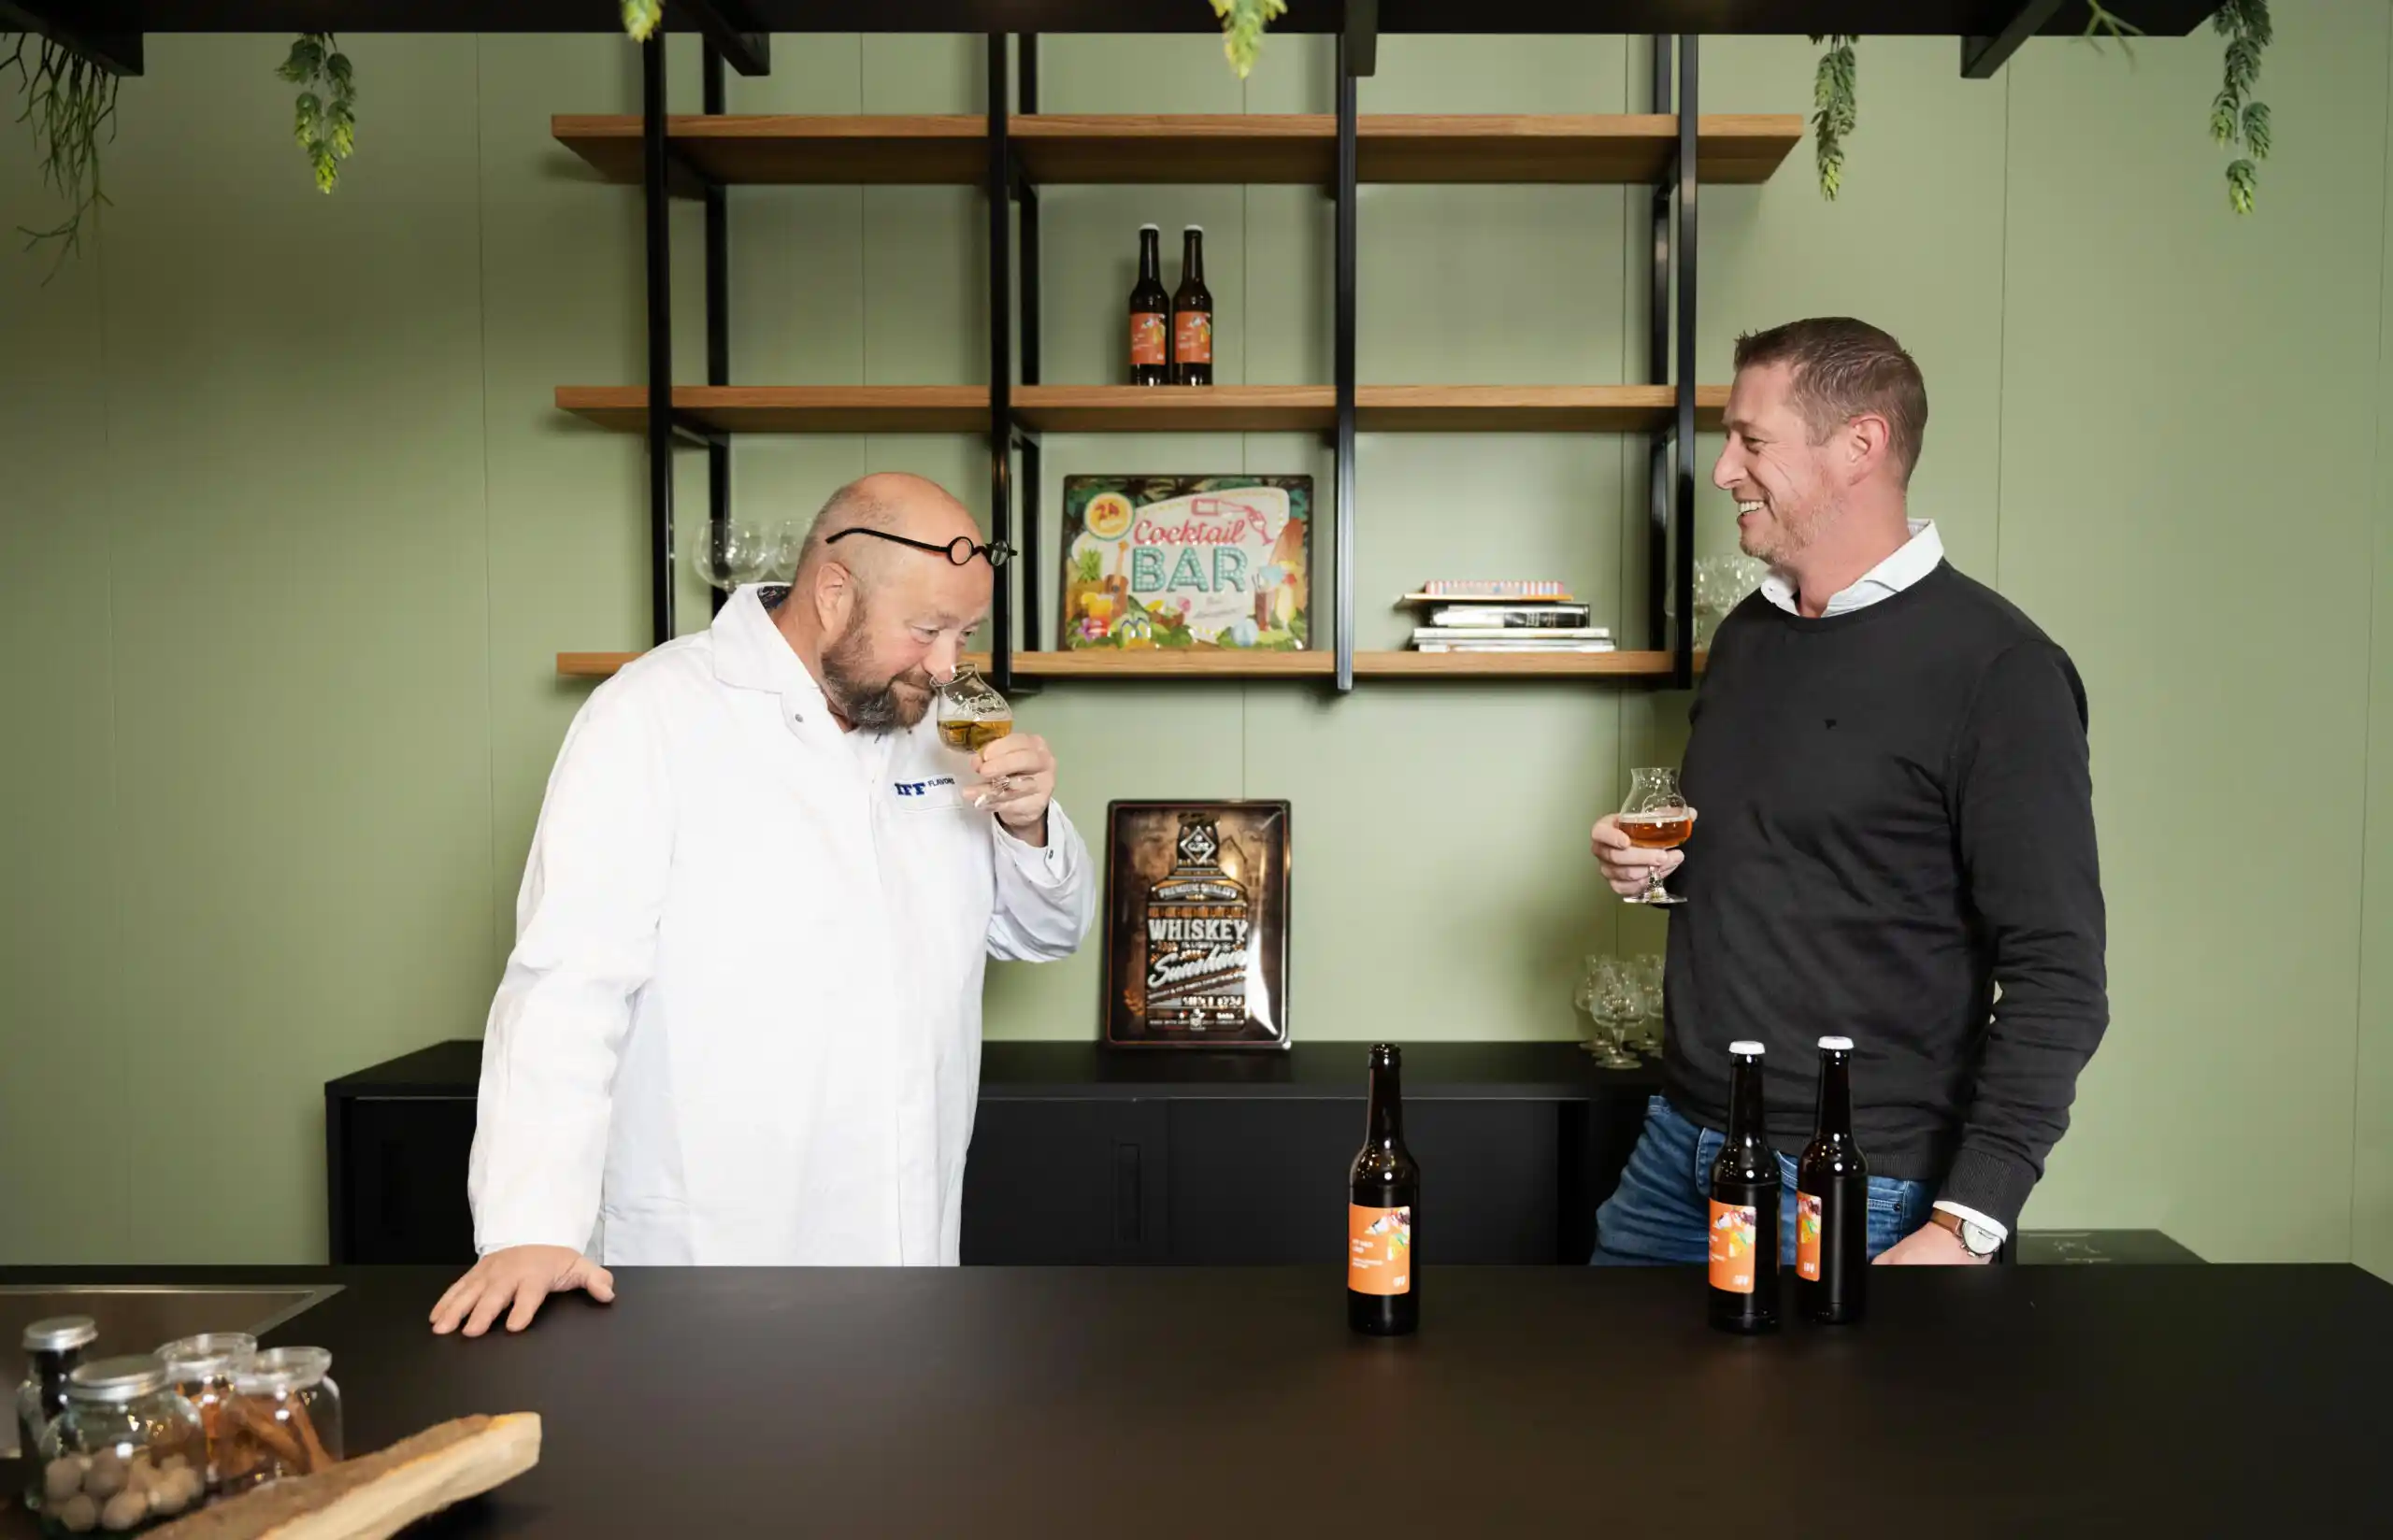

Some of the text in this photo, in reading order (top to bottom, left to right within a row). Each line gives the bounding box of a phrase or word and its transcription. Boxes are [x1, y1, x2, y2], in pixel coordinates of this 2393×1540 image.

[1133, 519, 1246, 545] Cocktail
[1132, 546, 1248, 592] BAR
[895, 781, 925, 795] IFF
[1148, 919, 1249, 941] WHISKEY
